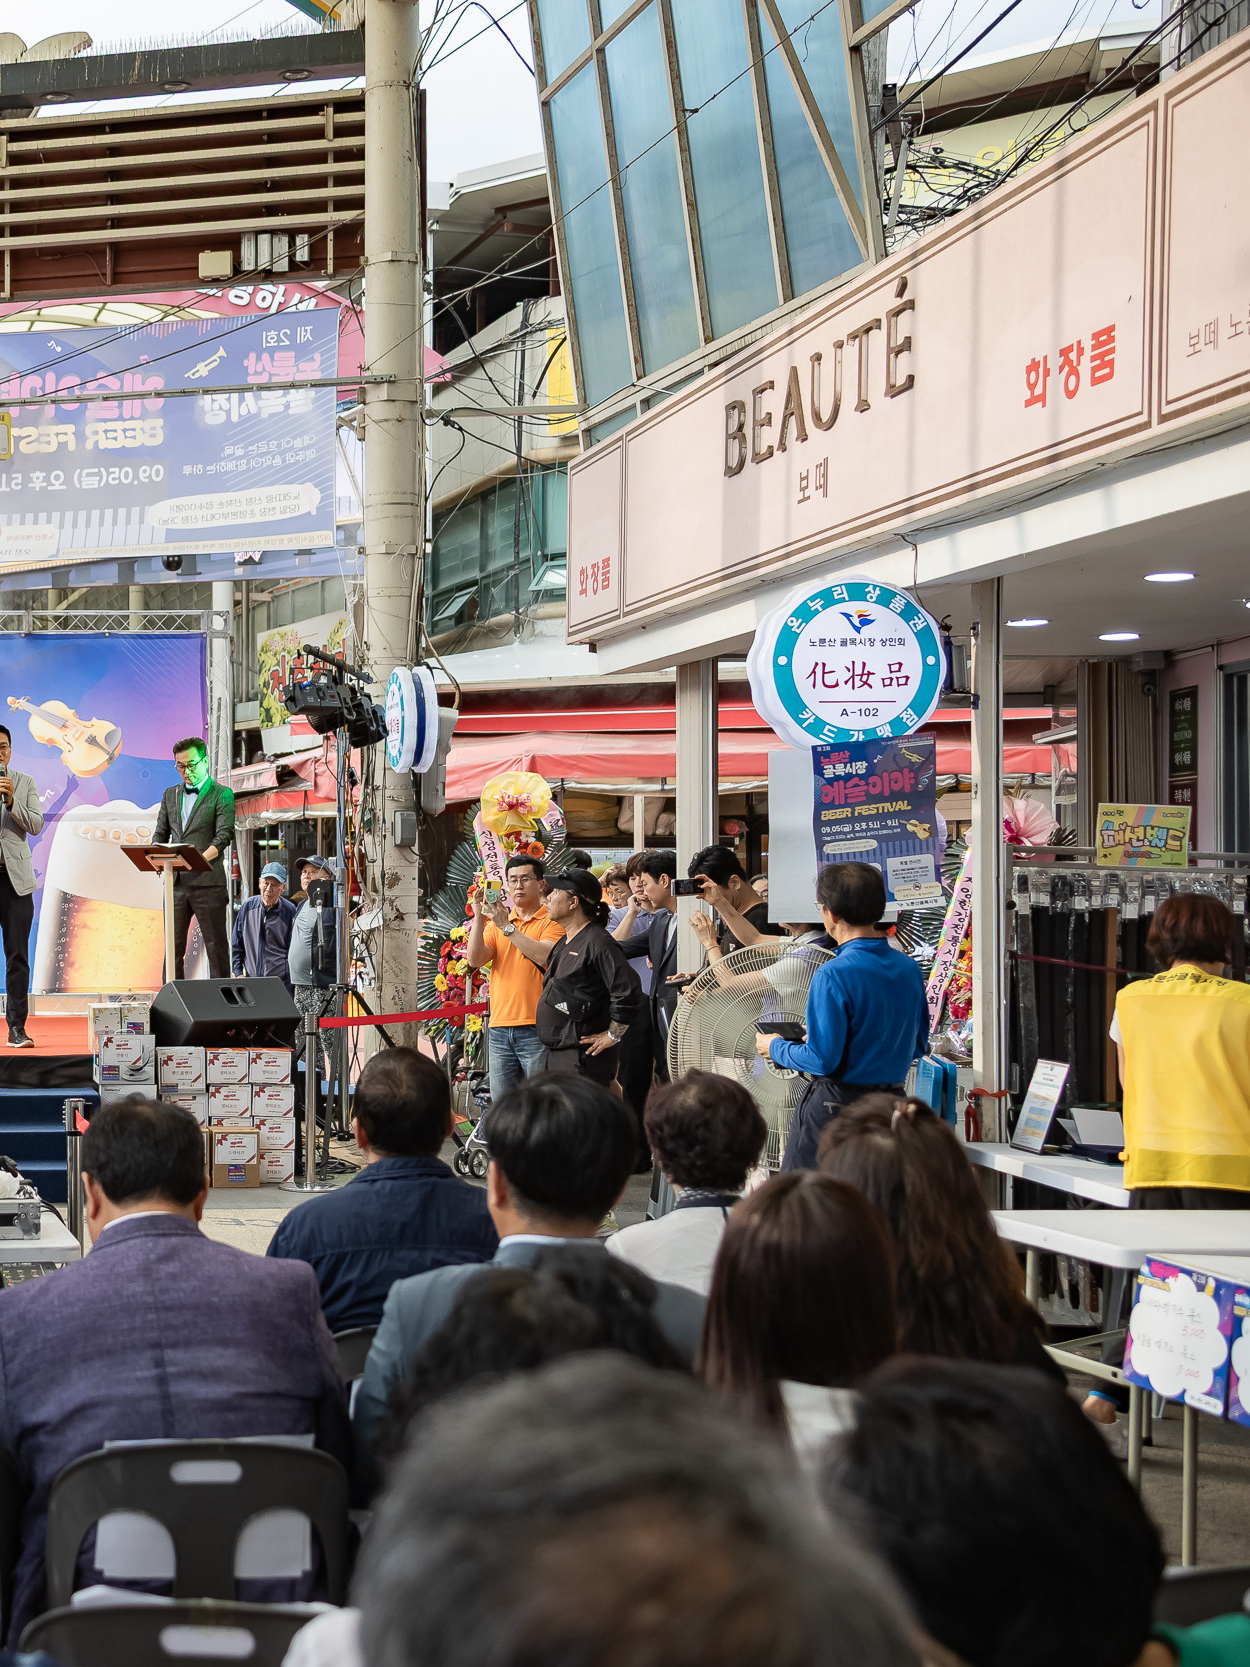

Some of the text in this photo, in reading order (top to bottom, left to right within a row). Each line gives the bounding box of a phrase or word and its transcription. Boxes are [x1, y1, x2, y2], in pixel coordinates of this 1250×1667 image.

[1186, 316, 1219, 358] 보떼
[722, 275, 916, 479] BEAUTÉ
[1023, 322, 1117, 410] 화장품
[796, 456, 829, 505] 보떼
[578, 554, 611, 598] 화장품
[809, 637, 906, 648] 노룬산 골목시장 상인회
[805, 660, 912, 692] 化妆品
[840, 707, 879, 718] A-102
[820, 750, 851, 767] 노룬산
[823, 760, 869, 778] 골목시장
[820, 767, 915, 806] 예술이야
[821, 800, 912, 821] BEER FESTIVAL
